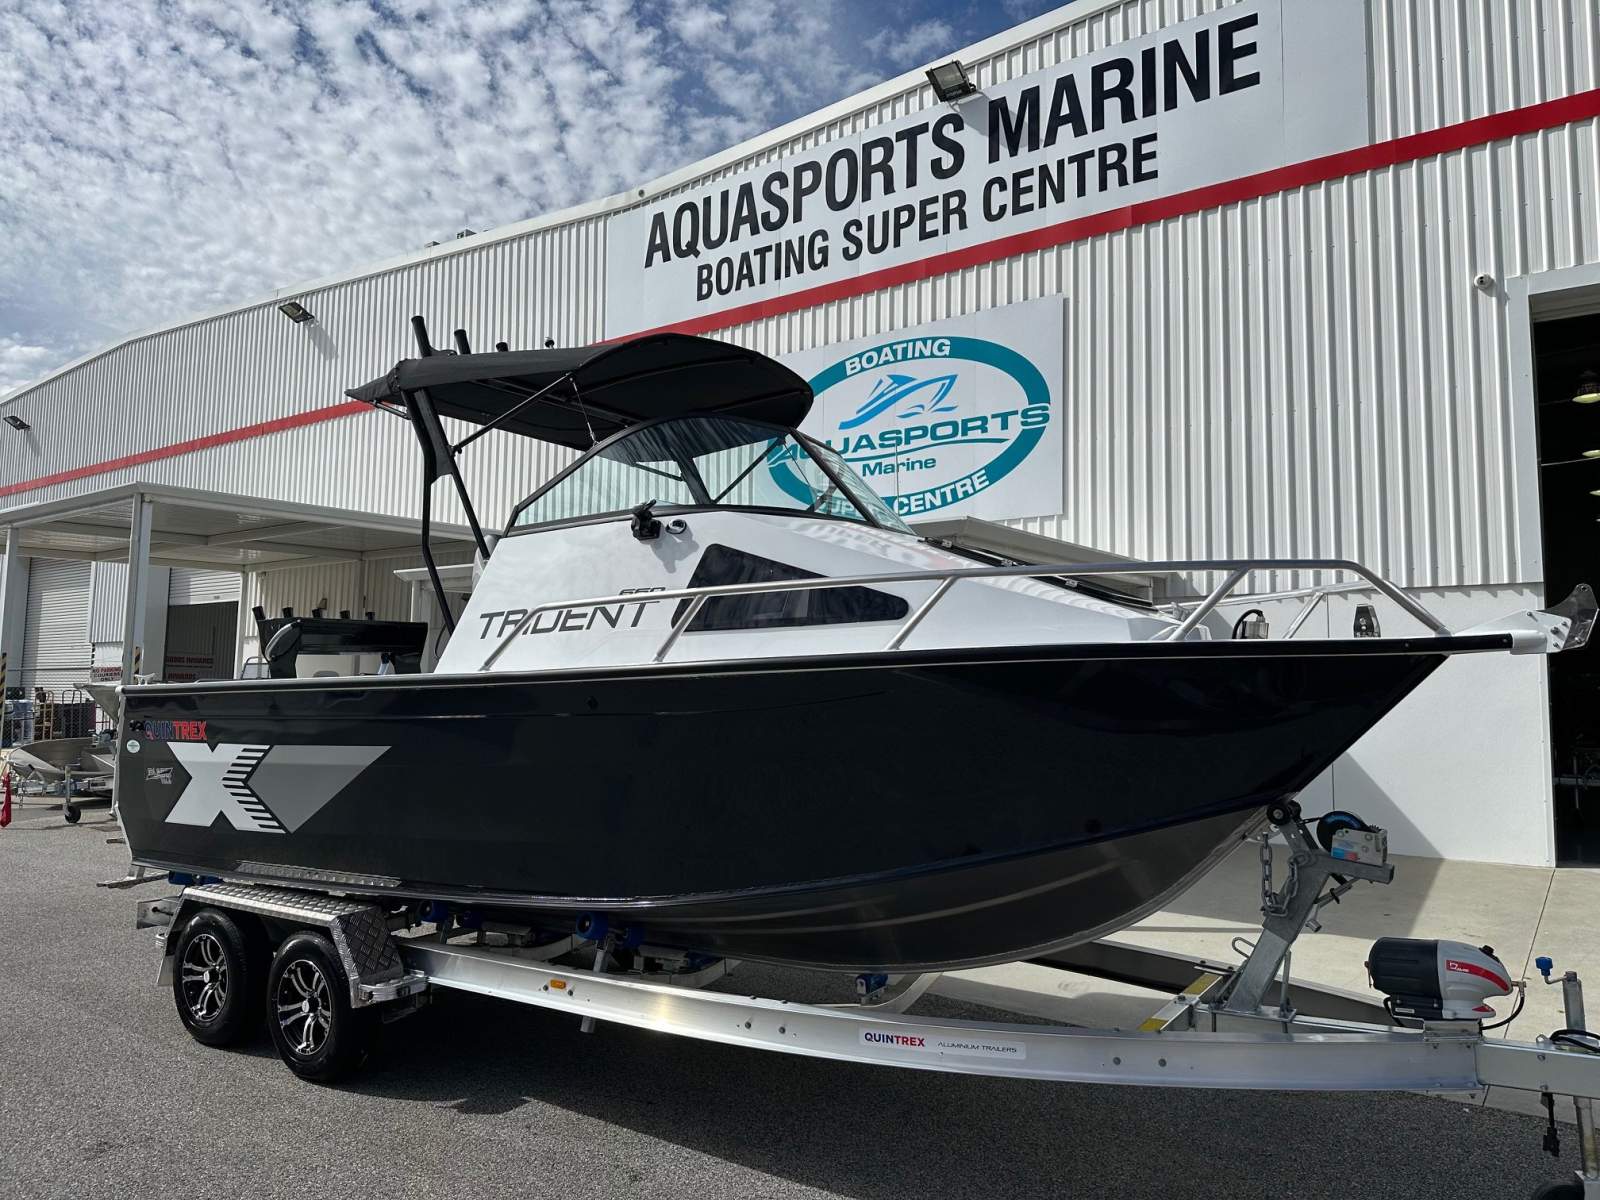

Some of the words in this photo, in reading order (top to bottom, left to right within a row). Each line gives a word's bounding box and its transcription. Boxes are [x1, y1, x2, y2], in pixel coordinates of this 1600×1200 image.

[644, 112, 965, 269] AQUASPORTS
[988, 12, 1261, 164] MARINE
[696, 229, 829, 302] BOATING
[842, 188, 968, 261] SUPER
[982, 132, 1160, 223] CENTRE
[845, 338, 951, 376] BOATING
[861, 456, 937, 477] Marine
[892, 468, 990, 515] CENTRE
[480, 600, 661, 639] TRDENT
[143, 720, 208, 741] QUINTREX
[864, 1032, 926, 1048] QUINTREX
[982, 1045, 1017, 1053] TRAILERS
